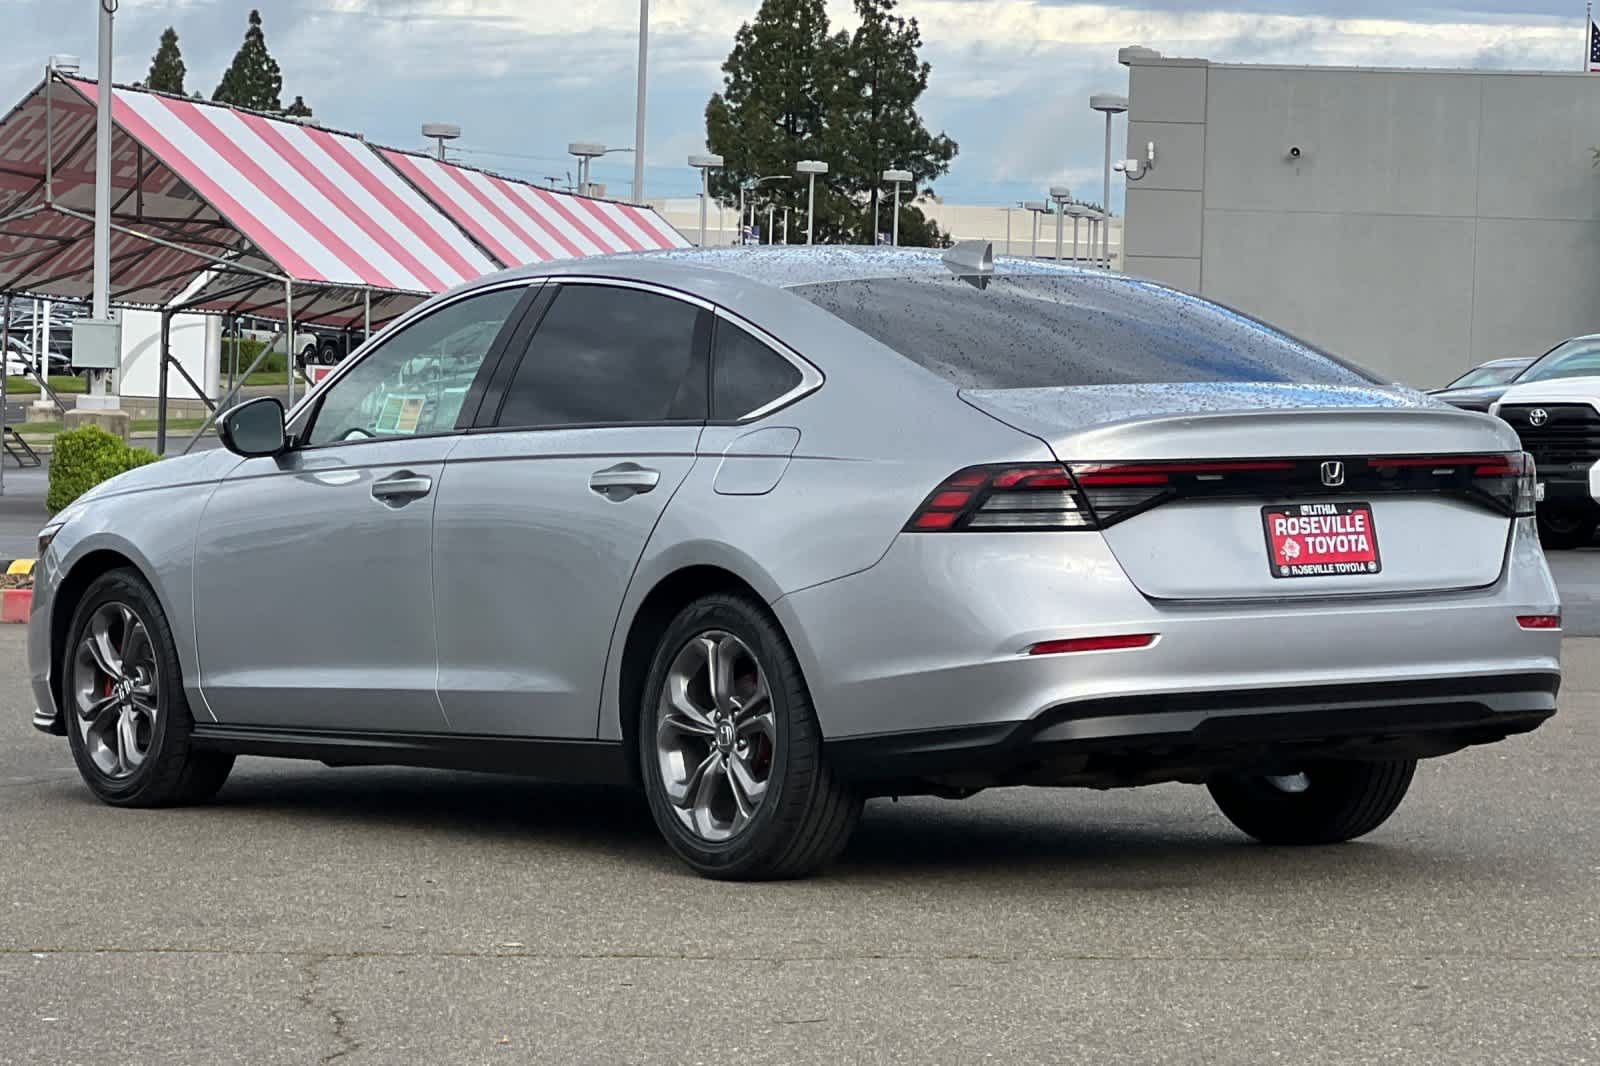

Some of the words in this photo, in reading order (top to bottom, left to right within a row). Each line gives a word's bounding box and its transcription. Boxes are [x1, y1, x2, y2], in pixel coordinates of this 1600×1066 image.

[1309, 504, 1338, 514] LITHIA
[1275, 515, 1364, 536] ROSEVILLE
[1305, 535, 1369, 554] TOYOTA
[1292, 564, 1335, 575] ROSEVILLE
[1335, 562, 1366, 573] TOYOTA
